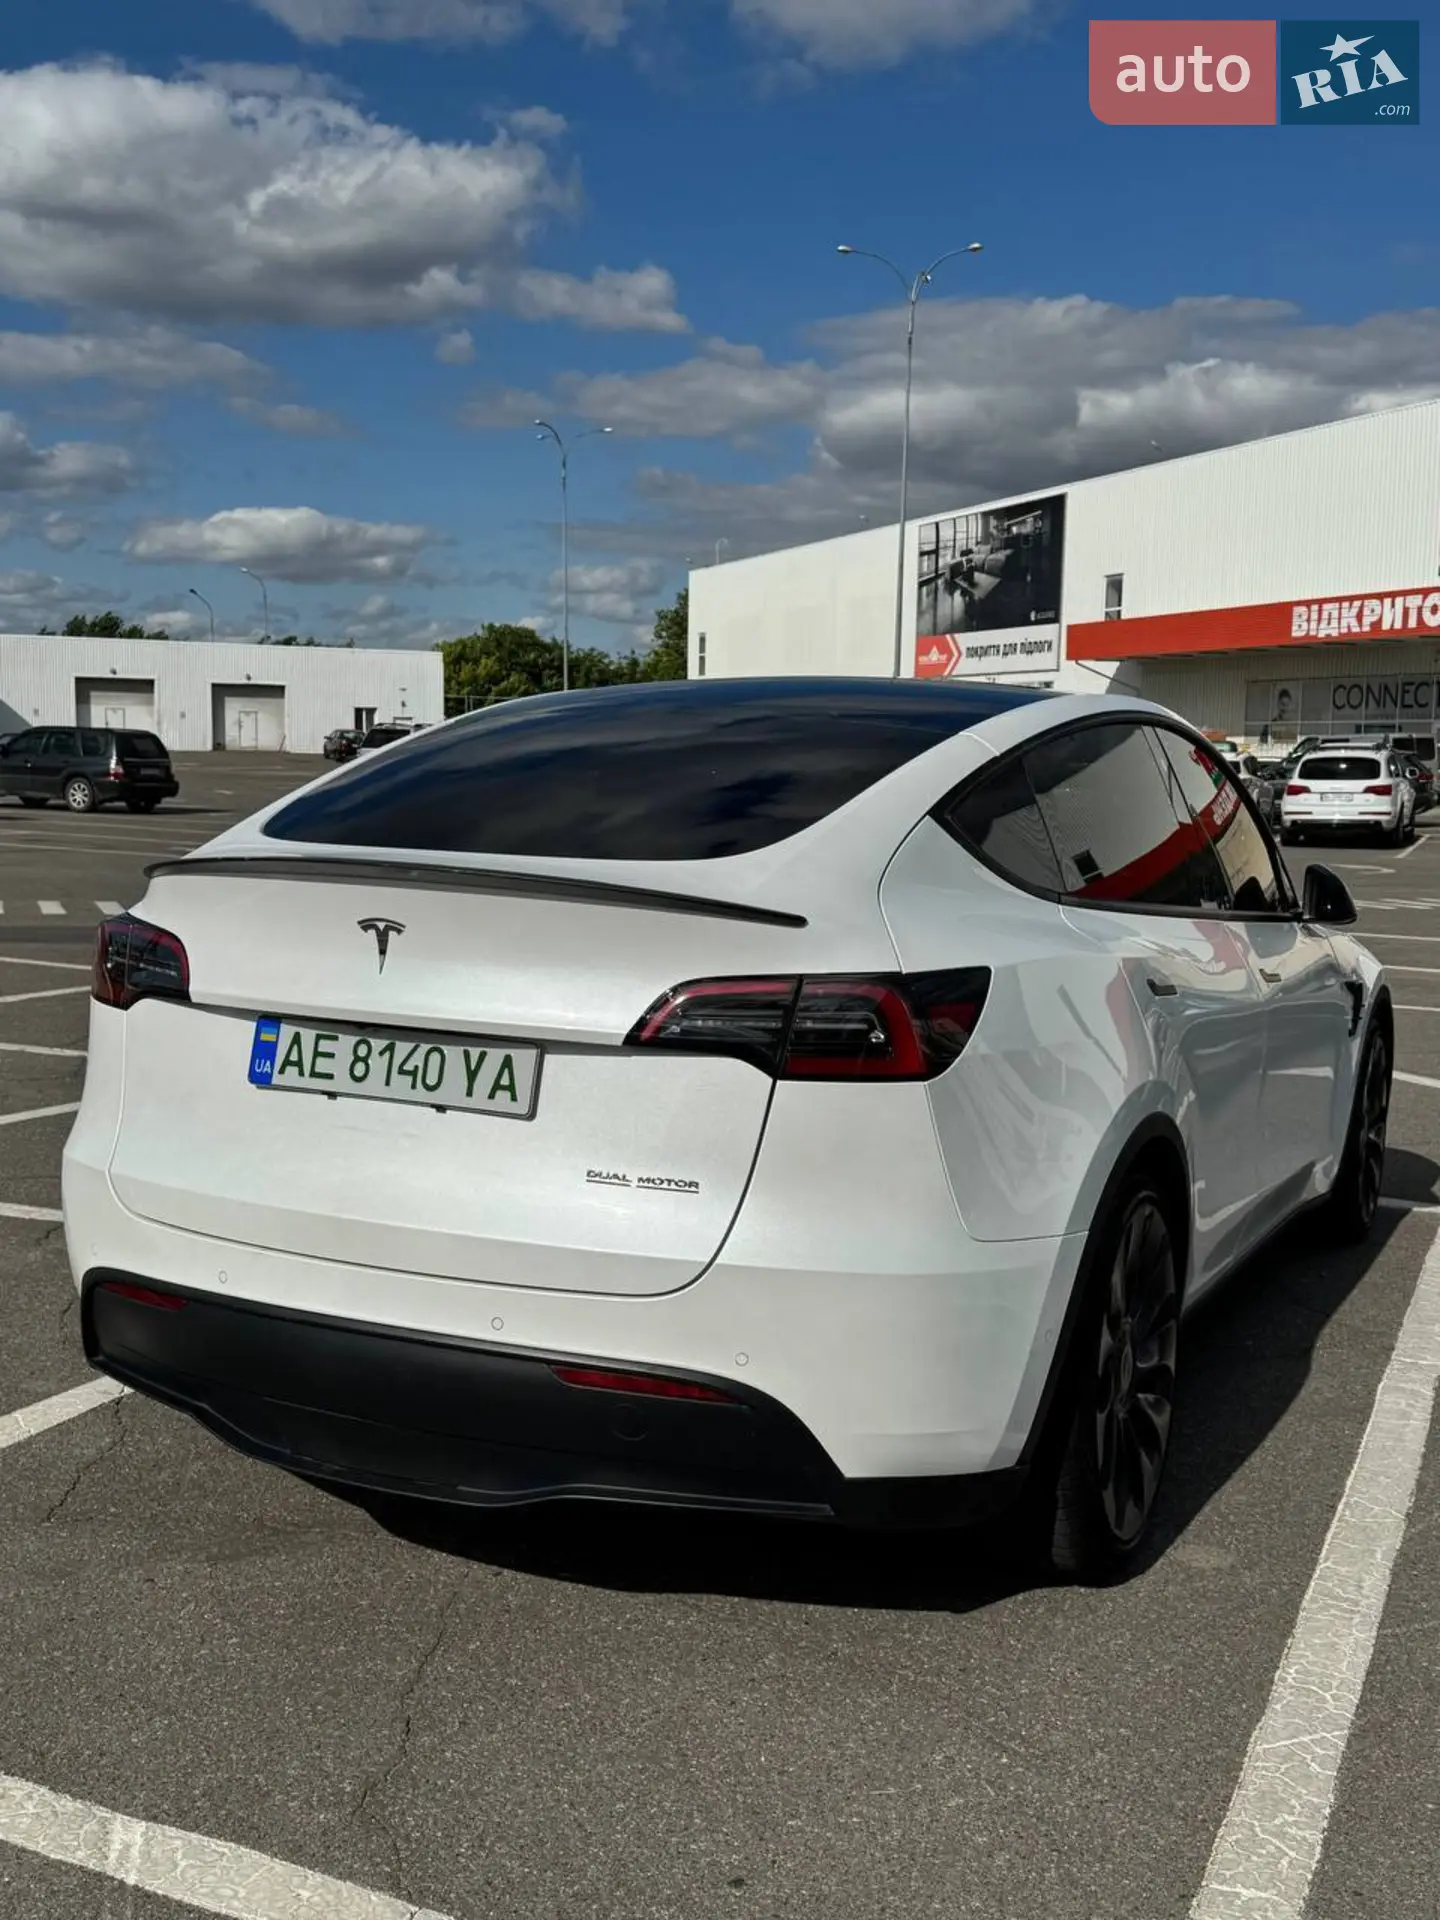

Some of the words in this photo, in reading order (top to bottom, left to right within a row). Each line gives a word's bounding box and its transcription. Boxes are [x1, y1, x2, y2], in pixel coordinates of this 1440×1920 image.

[965, 644, 1000, 660] покриття
[1002, 642, 1018, 658] для
[1020, 638, 1053, 656] підлоги
[254, 1058, 272, 1073] UA
[278, 1031, 339, 1080] AE
[349, 1038, 446, 1093] 8140
[463, 1048, 518, 1102] YA
[586, 1169, 632, 1183] DUAL
[637, 1176, 699, 1190] MOTOR
